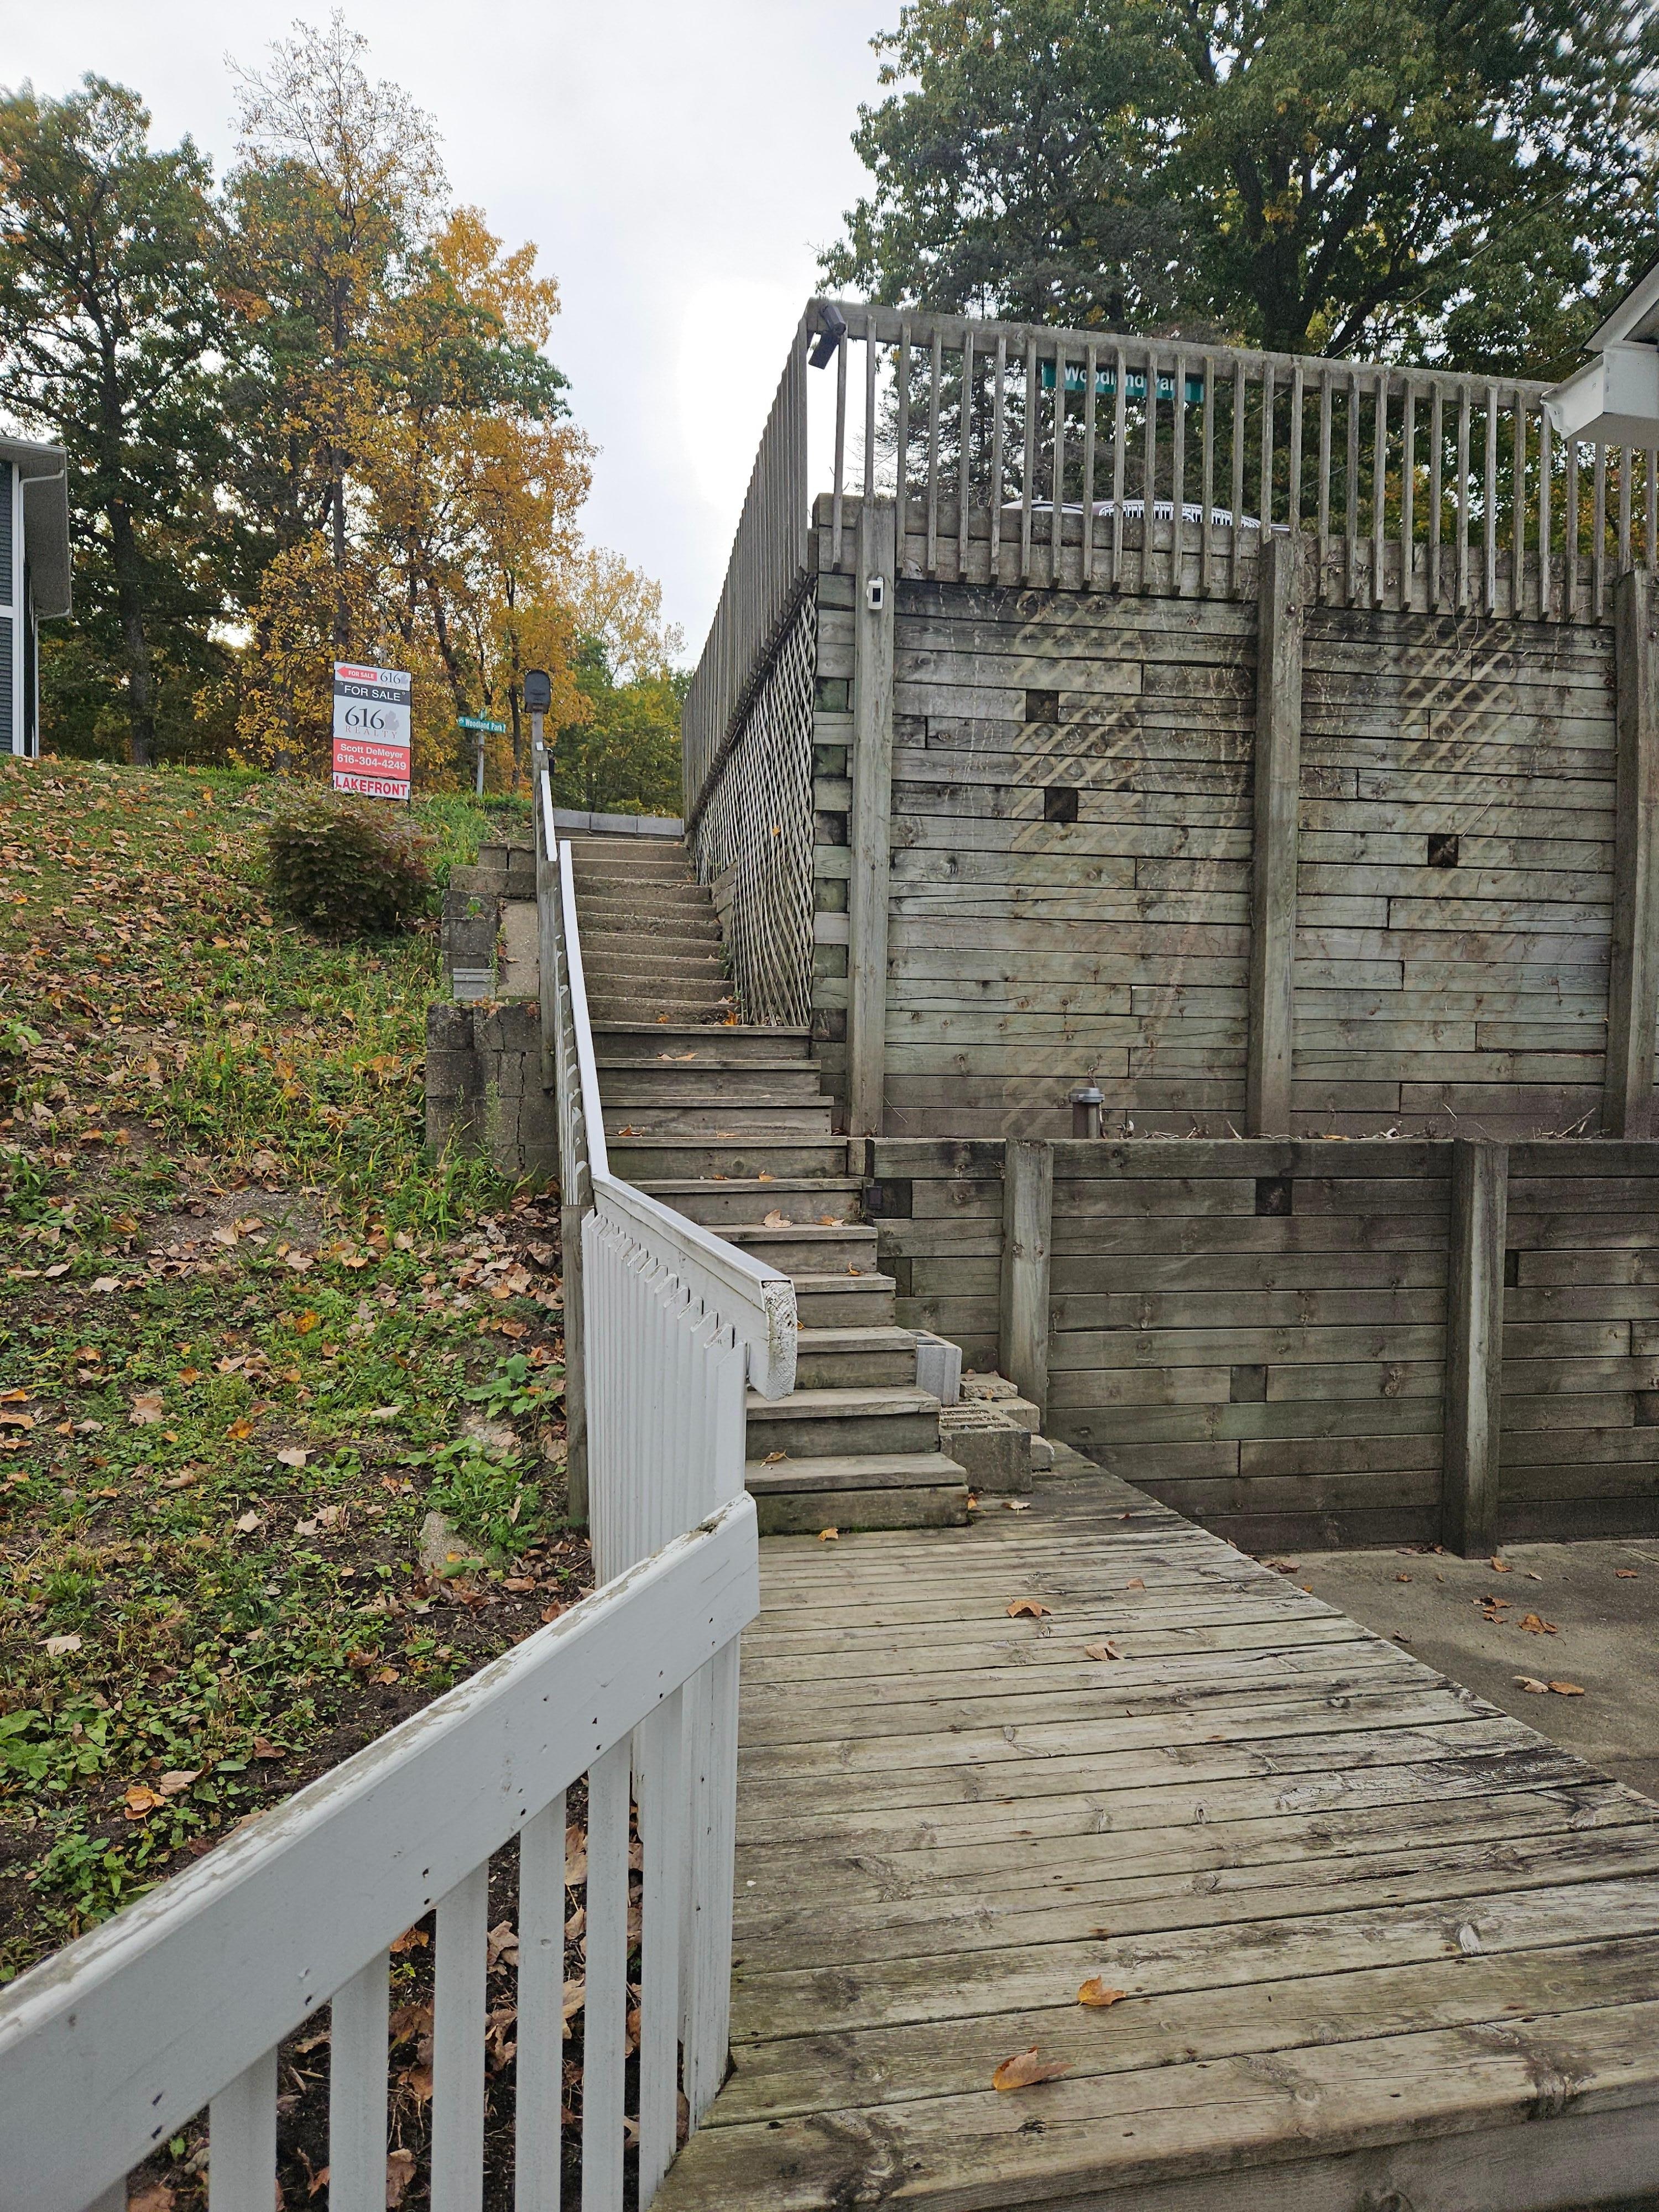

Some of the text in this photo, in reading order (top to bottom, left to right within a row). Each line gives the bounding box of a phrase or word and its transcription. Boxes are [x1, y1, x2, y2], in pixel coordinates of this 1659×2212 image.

[1065, 366, 1144, 388] Wodlnd
[361, 671, 374, 680] SALE
[380, 671, 400, 684] 616
[345, 685, 401, 701] FOR SALE
[345, 706, 384, 729] 616
[465, 718, 502, 732] Woodland Park
[345, 726, 398, 739] REALTY
[341, 744, 404, 759] Scott DeMeyer
[337, 754, 406, 770] 616-304-4249
[335, 775, 408, 796] LAKEFRONT
